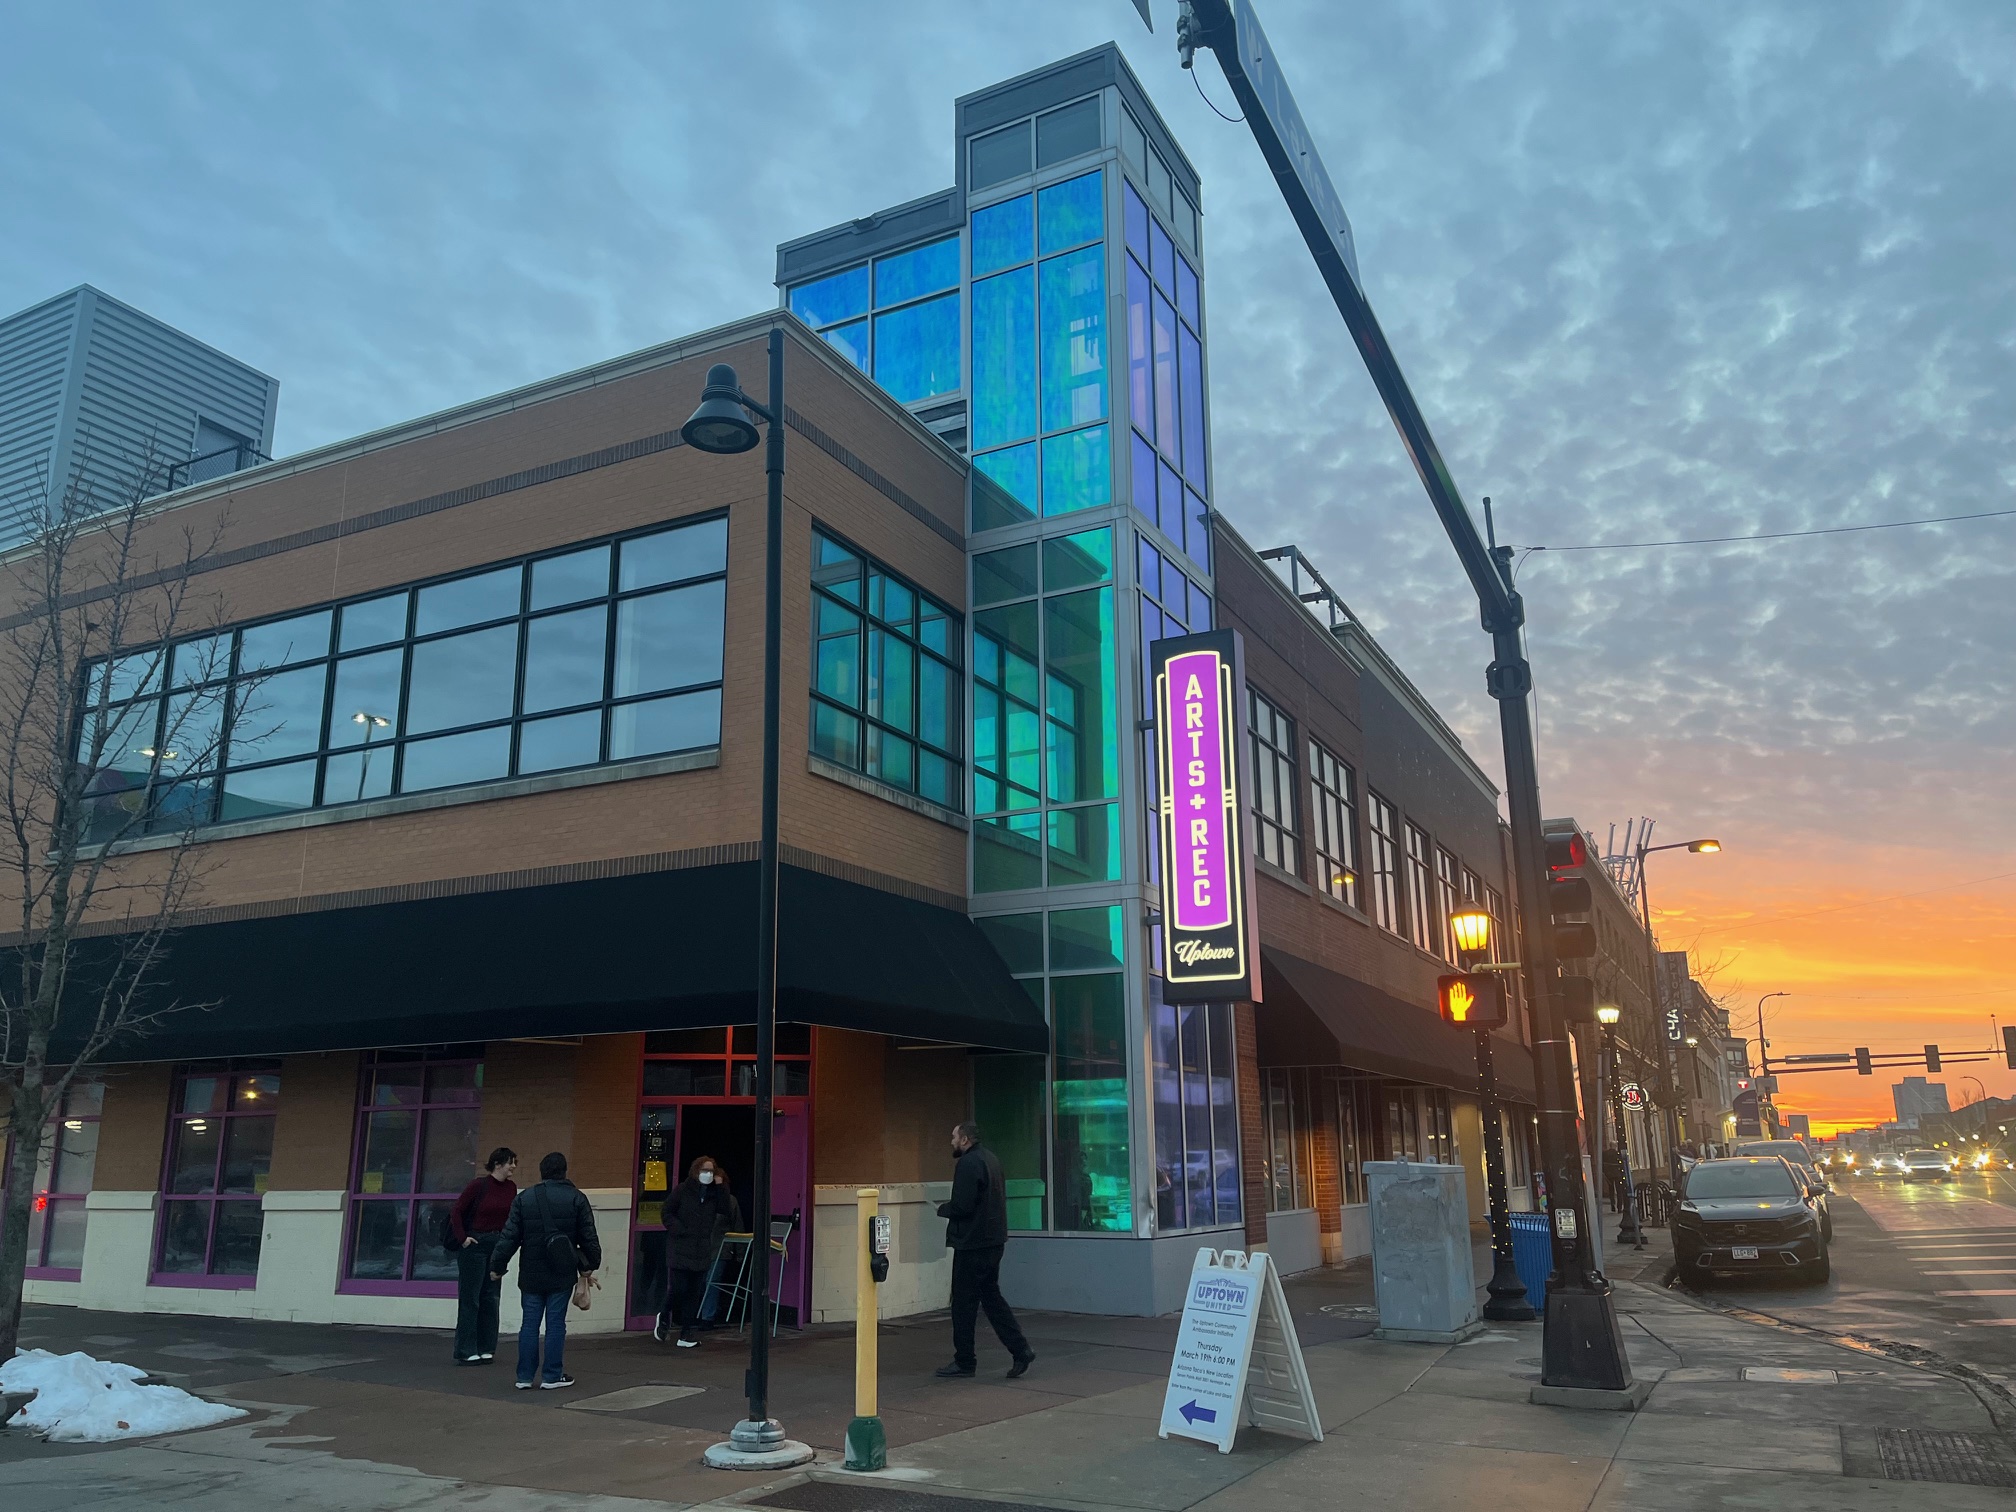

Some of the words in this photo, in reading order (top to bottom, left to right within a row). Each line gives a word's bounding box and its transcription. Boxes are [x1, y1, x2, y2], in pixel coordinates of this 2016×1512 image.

[1244, 10, 1263, 87] W
[1273, 74, 1325, 211] Lake
[1174, 939, 1234, 967] Uptown
[1198, 1286, 1245, 1303] UPTOWN
[1205, 1301, 1232, 1310] UNITED
[1192, 1326, 1216, 1334] Ambassador
[1215, 1322, 1237, 1331] Community
[1197, 1341, 1223, 1353] Thursday
[1181, 1350, 1199, 1359] March
[1200, 1353, 1212, 1362] 19th
[1213, 1356, 1226, 1364] 6:00
[1226, 1358, 1236, 1366] PM
[1216, 1371, 1234, 1379] Location
